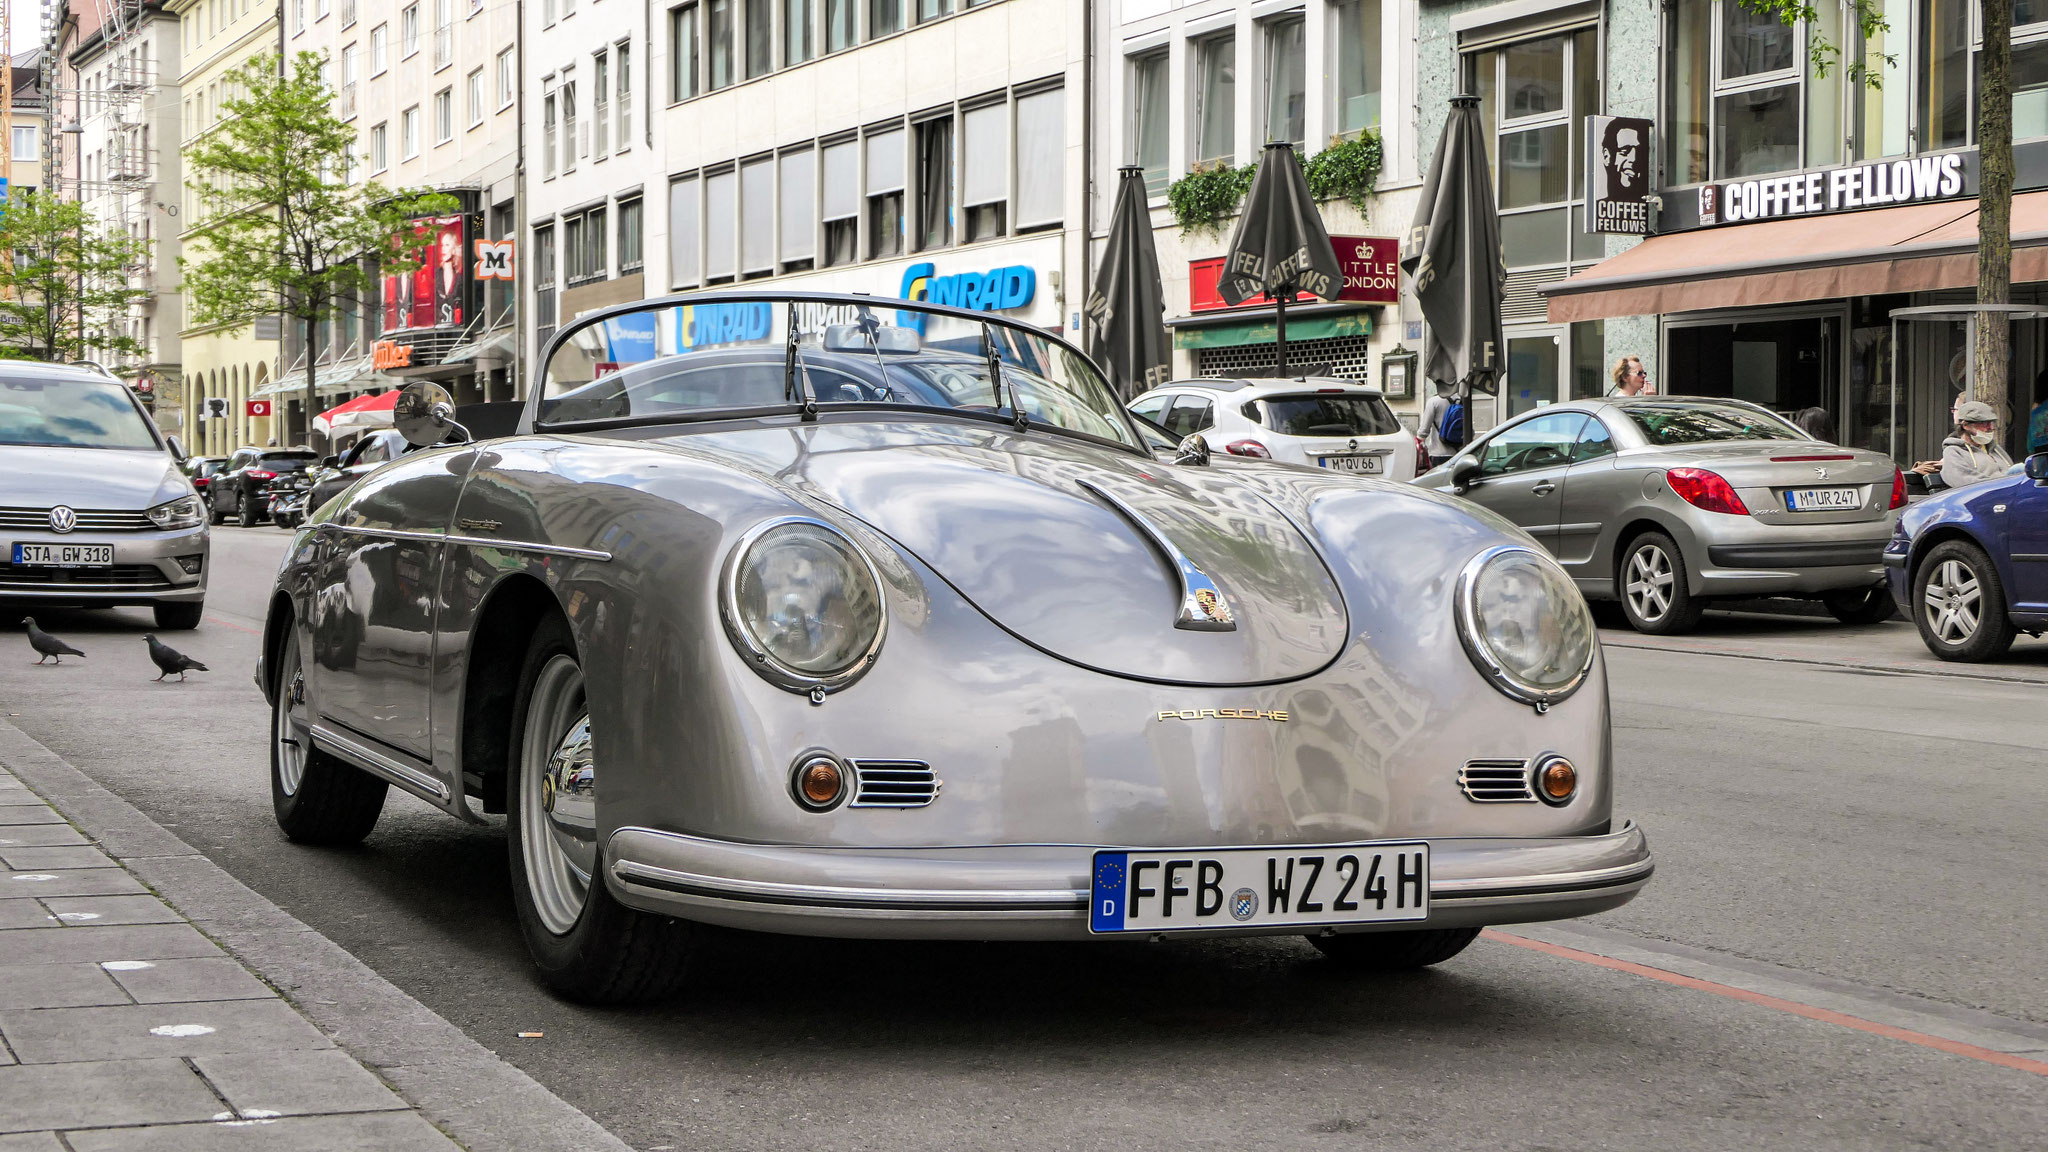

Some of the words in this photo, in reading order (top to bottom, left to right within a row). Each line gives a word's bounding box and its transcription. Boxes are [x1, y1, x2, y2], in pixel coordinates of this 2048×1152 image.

[1725, 172, 1823, 221] COFFEE
[1829, 153, 1962, 208] FELLOWS
[1598, 201, 1647, 220] COFFEE
[1597, 218, 1646, 233] FELLOWS
[485, 252, 506, 269] M
[1344, 261, 1396, 275] ITTLE
[1343, 276, 1396, 289] ONDON
[897, 262, 1037, 337] CONRAD
[1332, 459, 1340, 470] M
[1346, 459, 1360, 469] QV
[1362, 459, 1374, 469] 66
[1800, 493, 1809, 506] M
[1815, 492, 1832, 505] UR
[1834, 491, 1854, 505] 247
[23, 546, 51, 561] STA
[62, 547, 81, 562] GW
[84, 547, 110, 562] 318
[1157, 708, 1289, 722] PORSCHE
[1129, 859, 1224, 919] FFB
